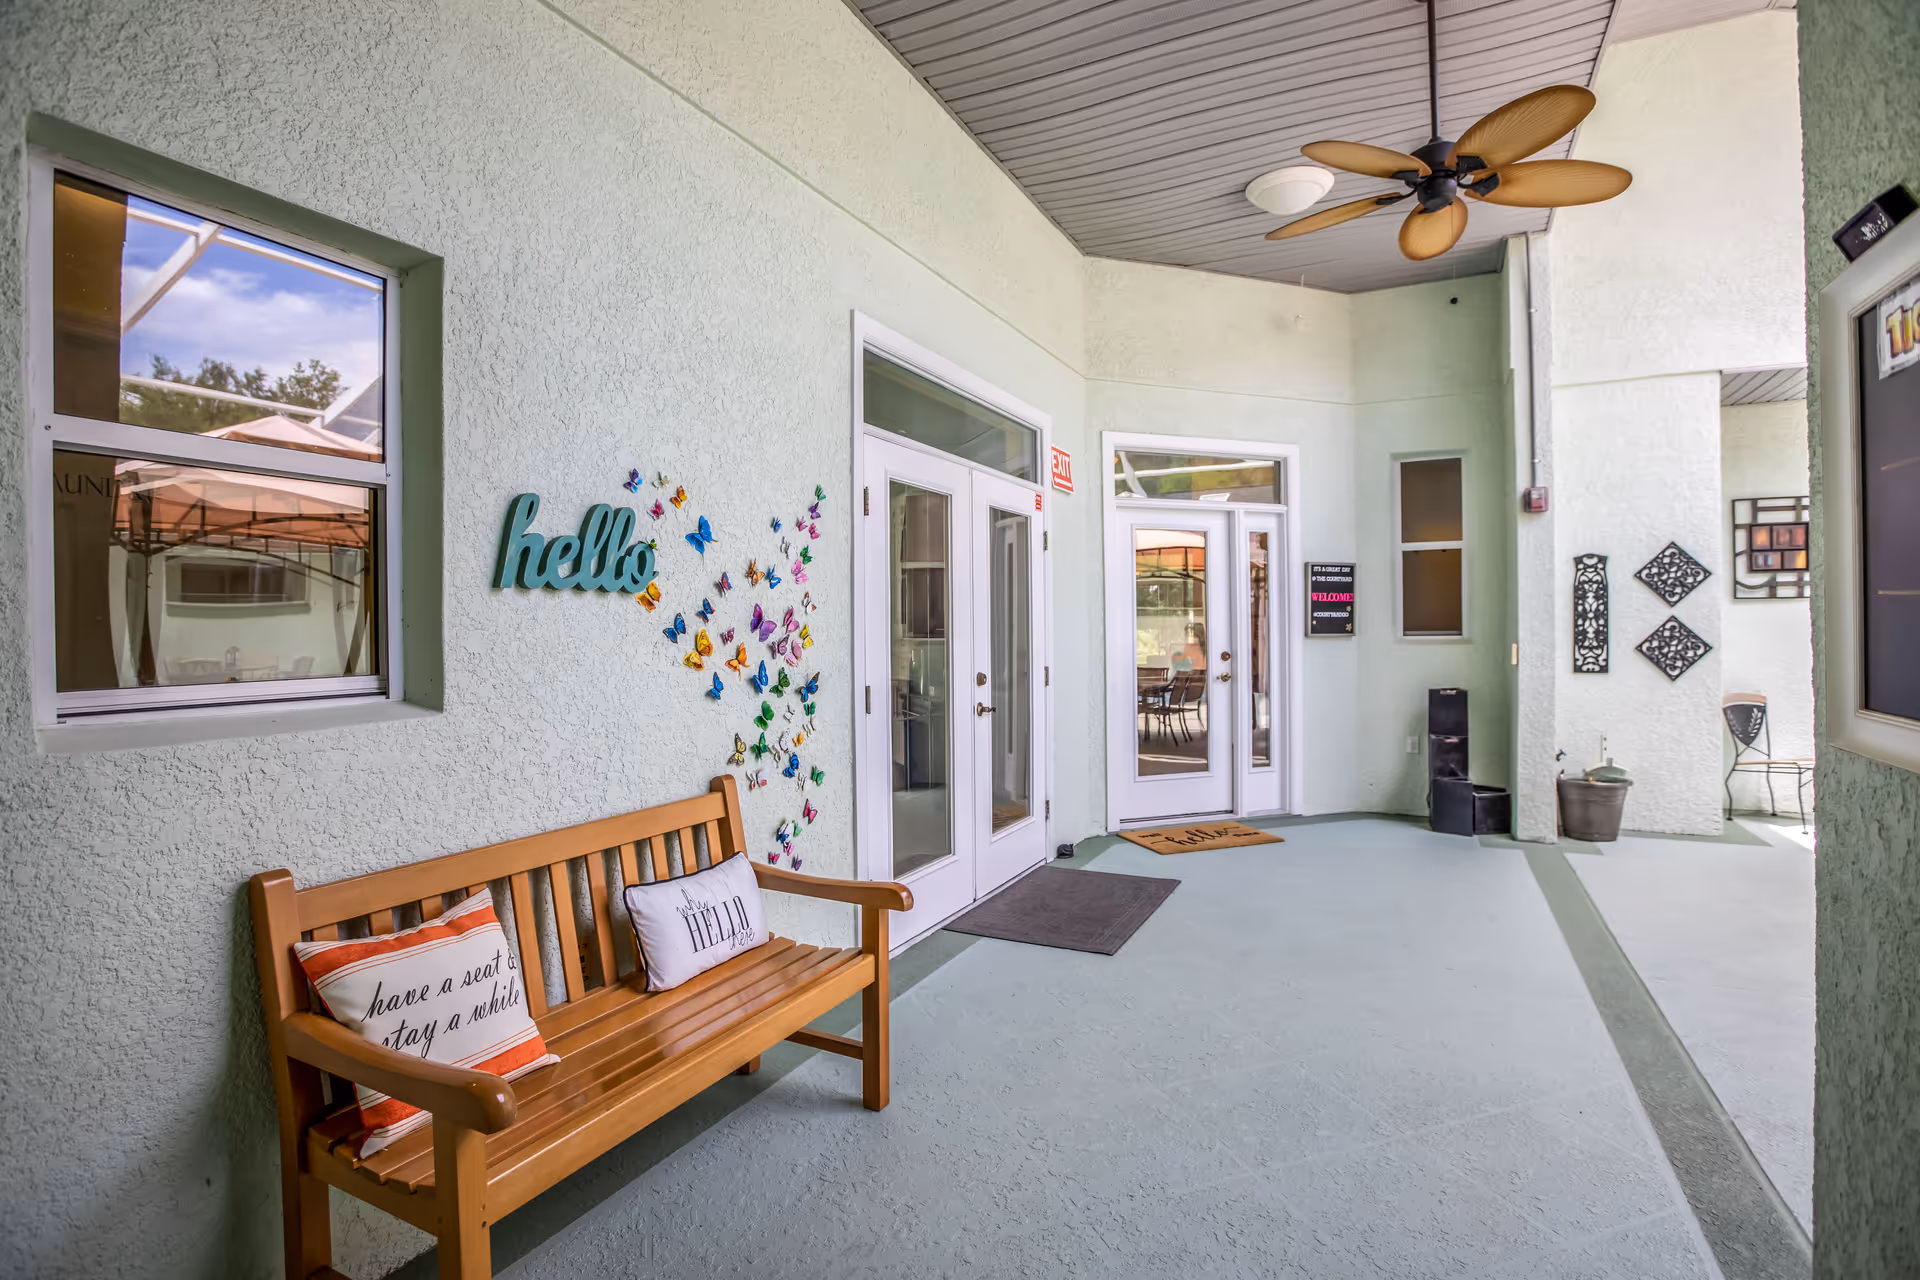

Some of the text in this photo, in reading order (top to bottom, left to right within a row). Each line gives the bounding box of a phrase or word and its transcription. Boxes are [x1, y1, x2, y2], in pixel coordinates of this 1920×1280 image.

[1052, 450, 1070, 479] EXIT
[492, 492, 660, 594] hello
[1150, 826, 1240, 846] hello
[682, 895, 750, 954] HELLO
[361, 980, 430, 1023] have
[436, 976, 453, 997] a
[459, 948, 503, 989] seat
[443, 1012, 461, 1035] a
[466, 975, 520, 1026] while
